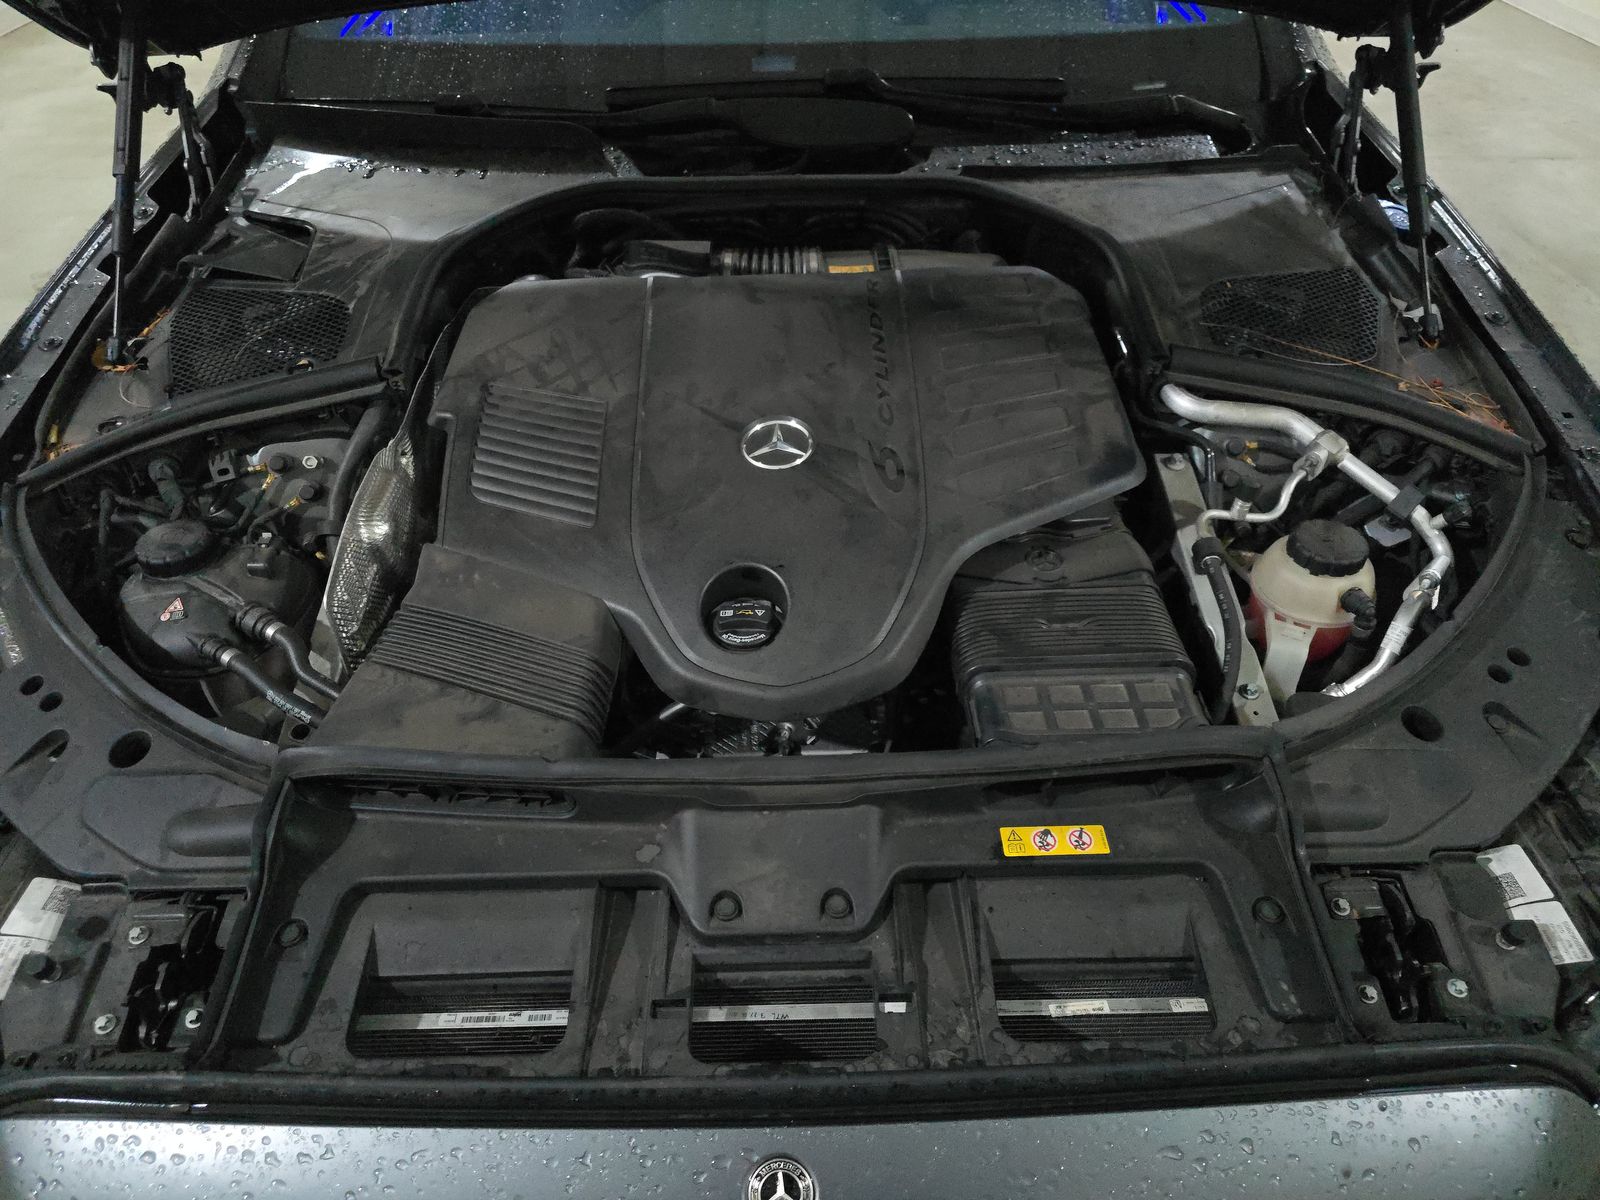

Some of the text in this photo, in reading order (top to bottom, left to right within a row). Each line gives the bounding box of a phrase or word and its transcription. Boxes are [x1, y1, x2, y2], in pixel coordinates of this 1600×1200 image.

[865, 278, 905, 493] 6 CYLINDER
[758, 1161, 802, 1176] MERCEDES
